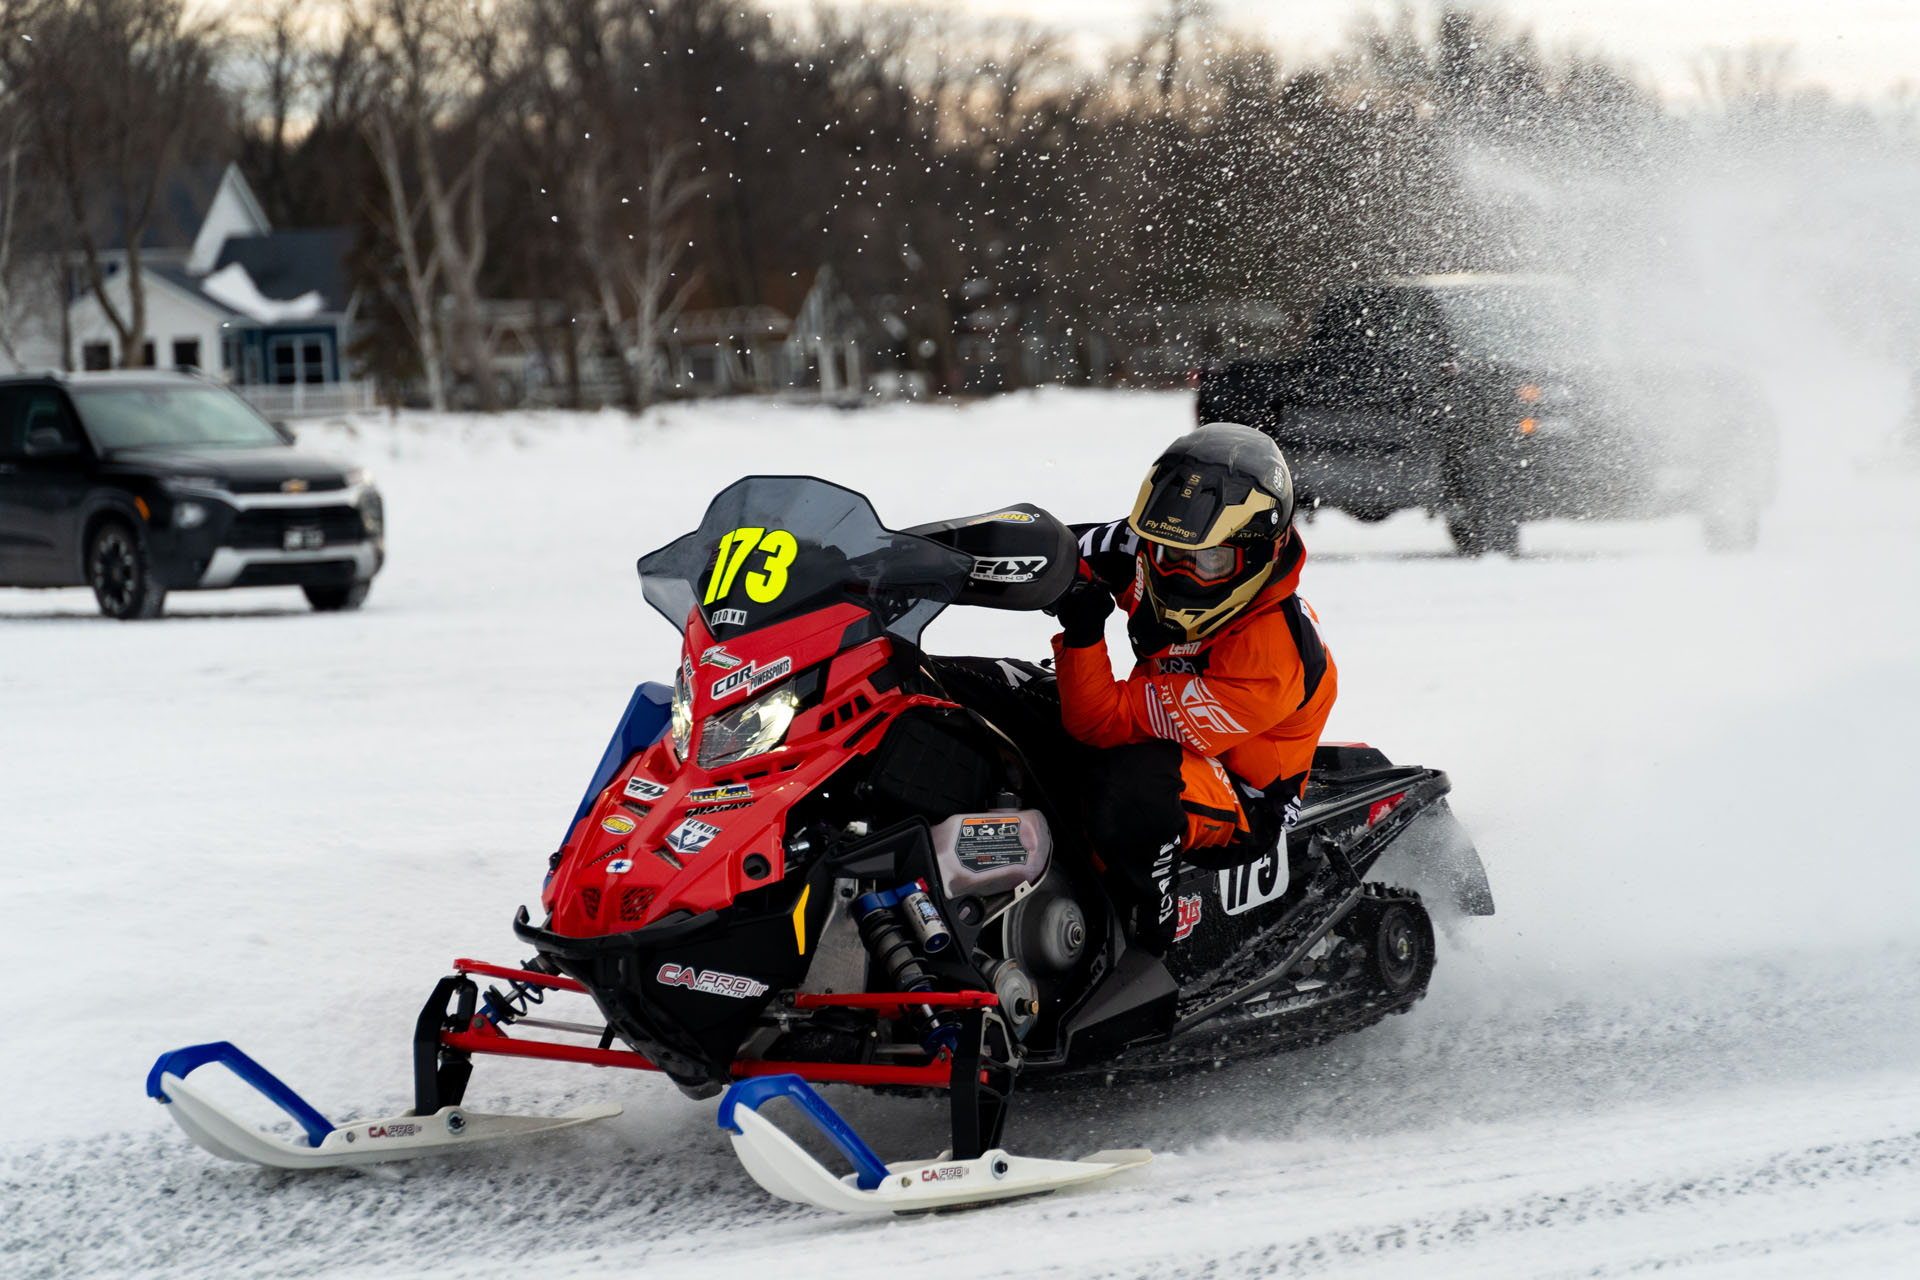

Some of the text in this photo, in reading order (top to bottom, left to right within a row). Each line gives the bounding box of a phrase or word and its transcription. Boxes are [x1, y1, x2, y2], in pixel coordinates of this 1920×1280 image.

[1145, 520, 1159, 532] Fly
[703, 527, 798, 606] 173
[974, 560, 1044, 576] FLY
[713, 666, 752, 696] COR
[750, 660, 790, 690] POWERSPORTS
[629, 778, 667, 797] FLY
[685, 818, 723, 836] VENOM
